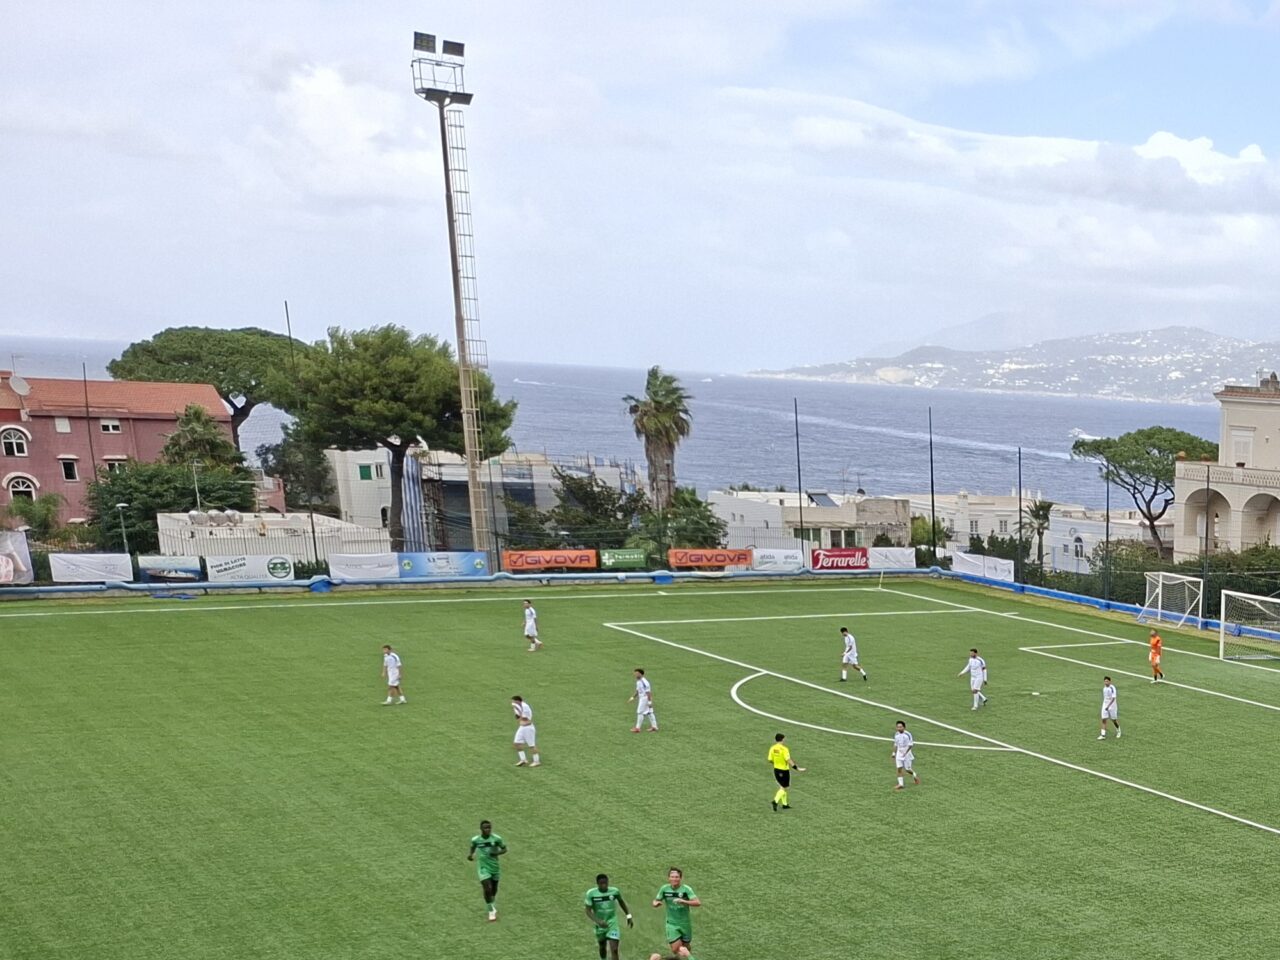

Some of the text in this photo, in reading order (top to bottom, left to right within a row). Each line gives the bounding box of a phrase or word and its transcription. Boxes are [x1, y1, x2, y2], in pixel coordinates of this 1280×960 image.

[525, 554, 591, 565] GIVOVA
[687, 553, 748, 563] GIVOVA
[814, 550, 867, 569] Ferrarelle
